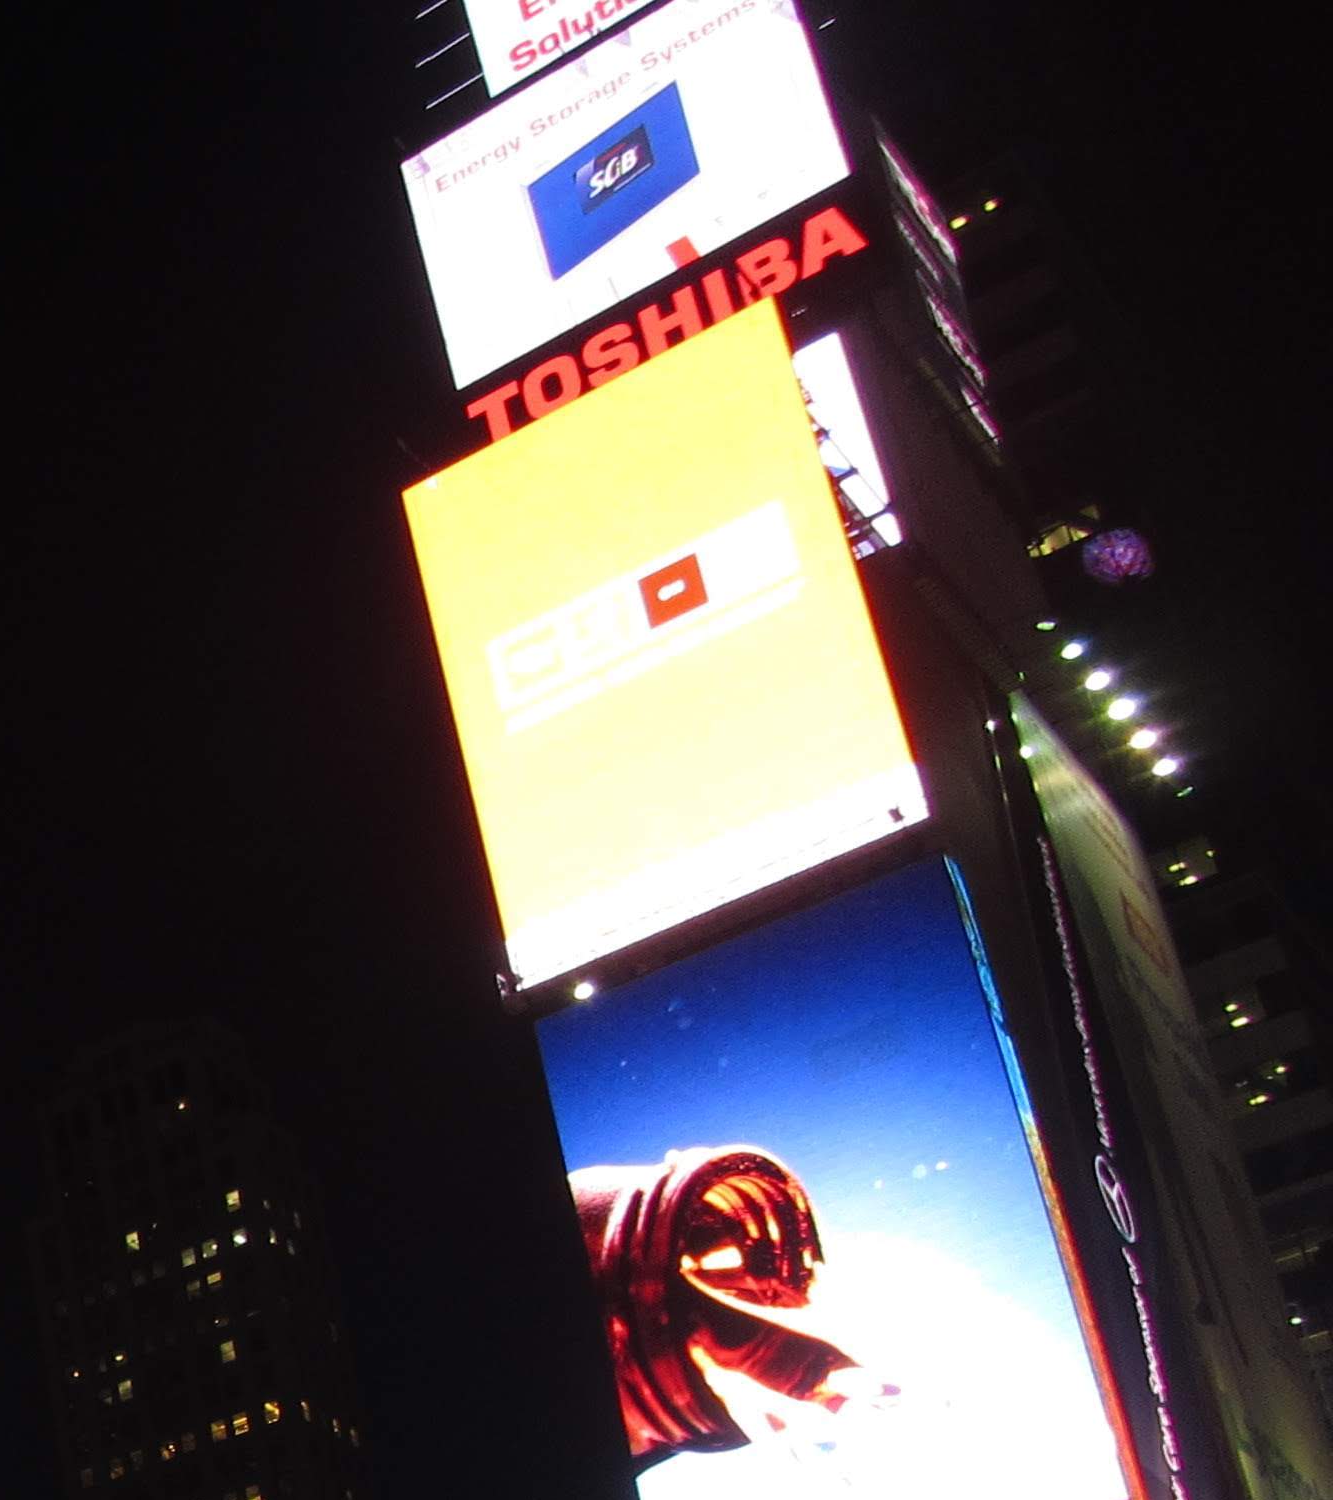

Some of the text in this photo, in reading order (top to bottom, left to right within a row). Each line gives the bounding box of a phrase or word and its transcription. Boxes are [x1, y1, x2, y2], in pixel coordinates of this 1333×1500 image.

[434, 2, 757, 194] Energy Storage Systems
[507, 0, 637, 72] Solut
[467, 206, 869, 443] TOSHIBA
